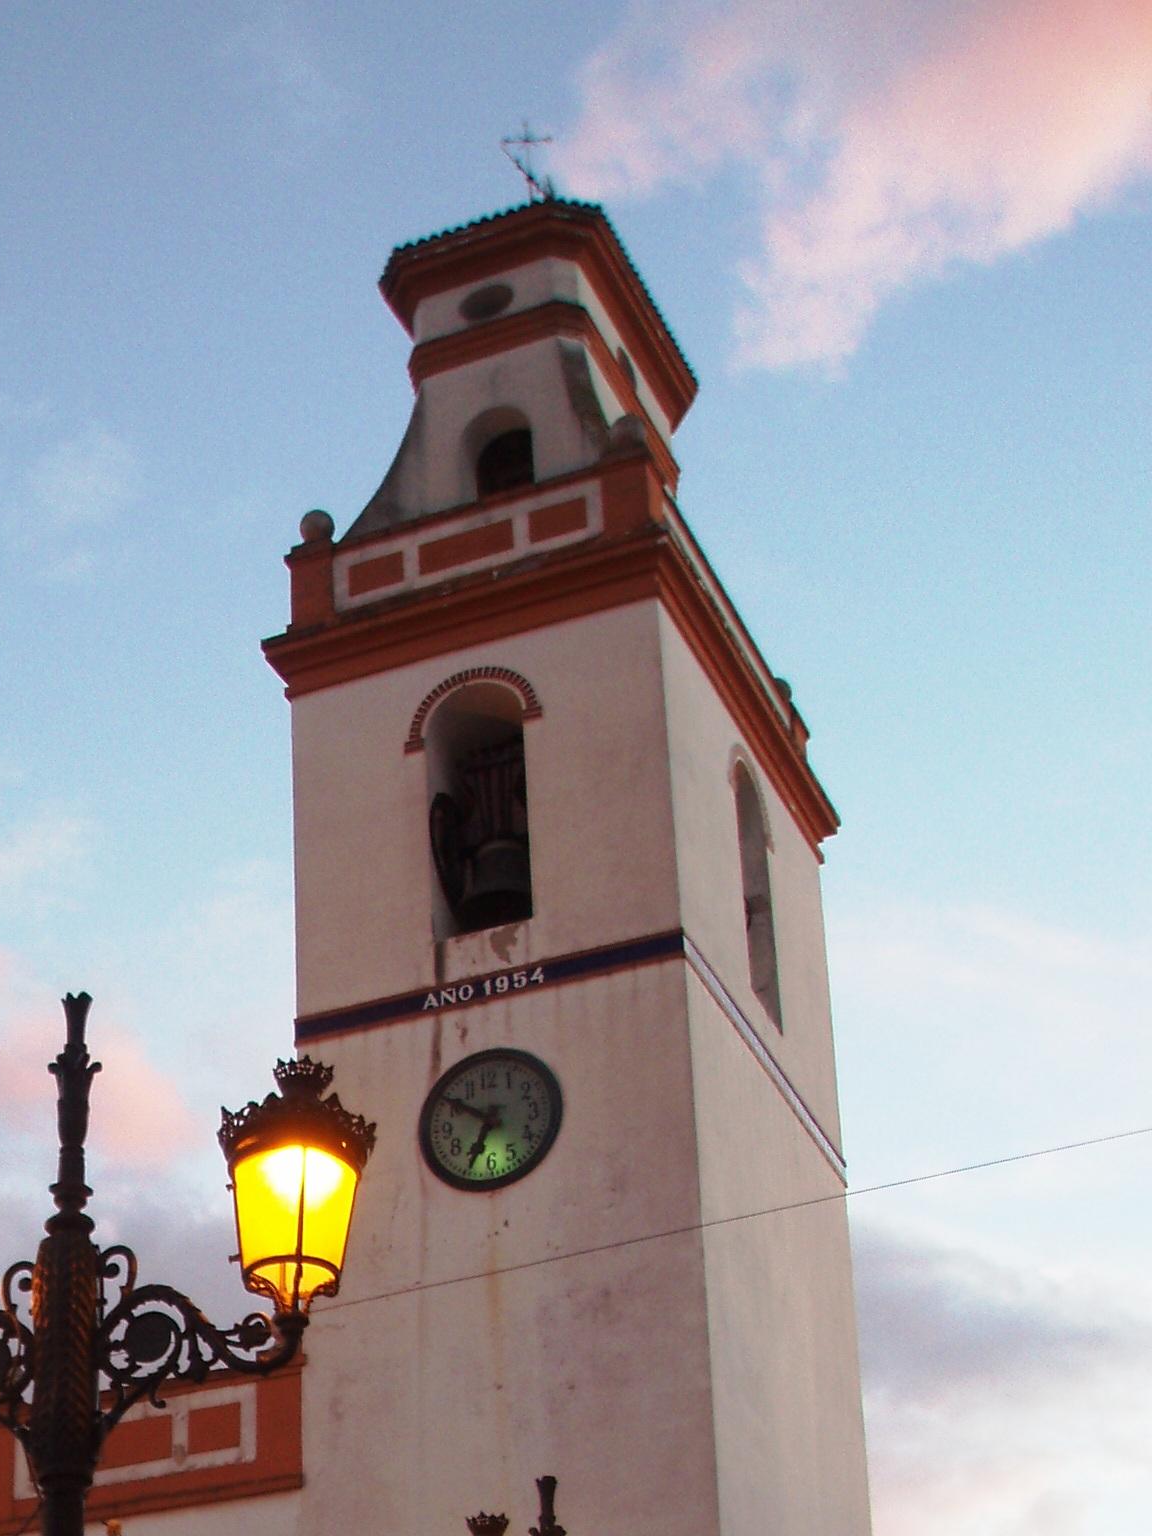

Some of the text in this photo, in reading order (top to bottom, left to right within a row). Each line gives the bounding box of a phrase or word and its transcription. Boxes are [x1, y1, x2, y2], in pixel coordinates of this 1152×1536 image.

[423, 966, 544, 1010] AÑO 1954
[480, 1070, 499, 1090] 12
[506, 1072, 513, 1089] 1
[466, 1080, 476, 1100] 11
[521, 1082, 532, 1100] 2
[528, 1102, 540, 1121] 3
[441, 1121, 453, 1140] 9
[522, 1124, 534, 1142] 4
[450, 1138, 462, 1156] 8
[506, 1144, 517, 1162] 5
[486, 1152, 498, 1171] 6
